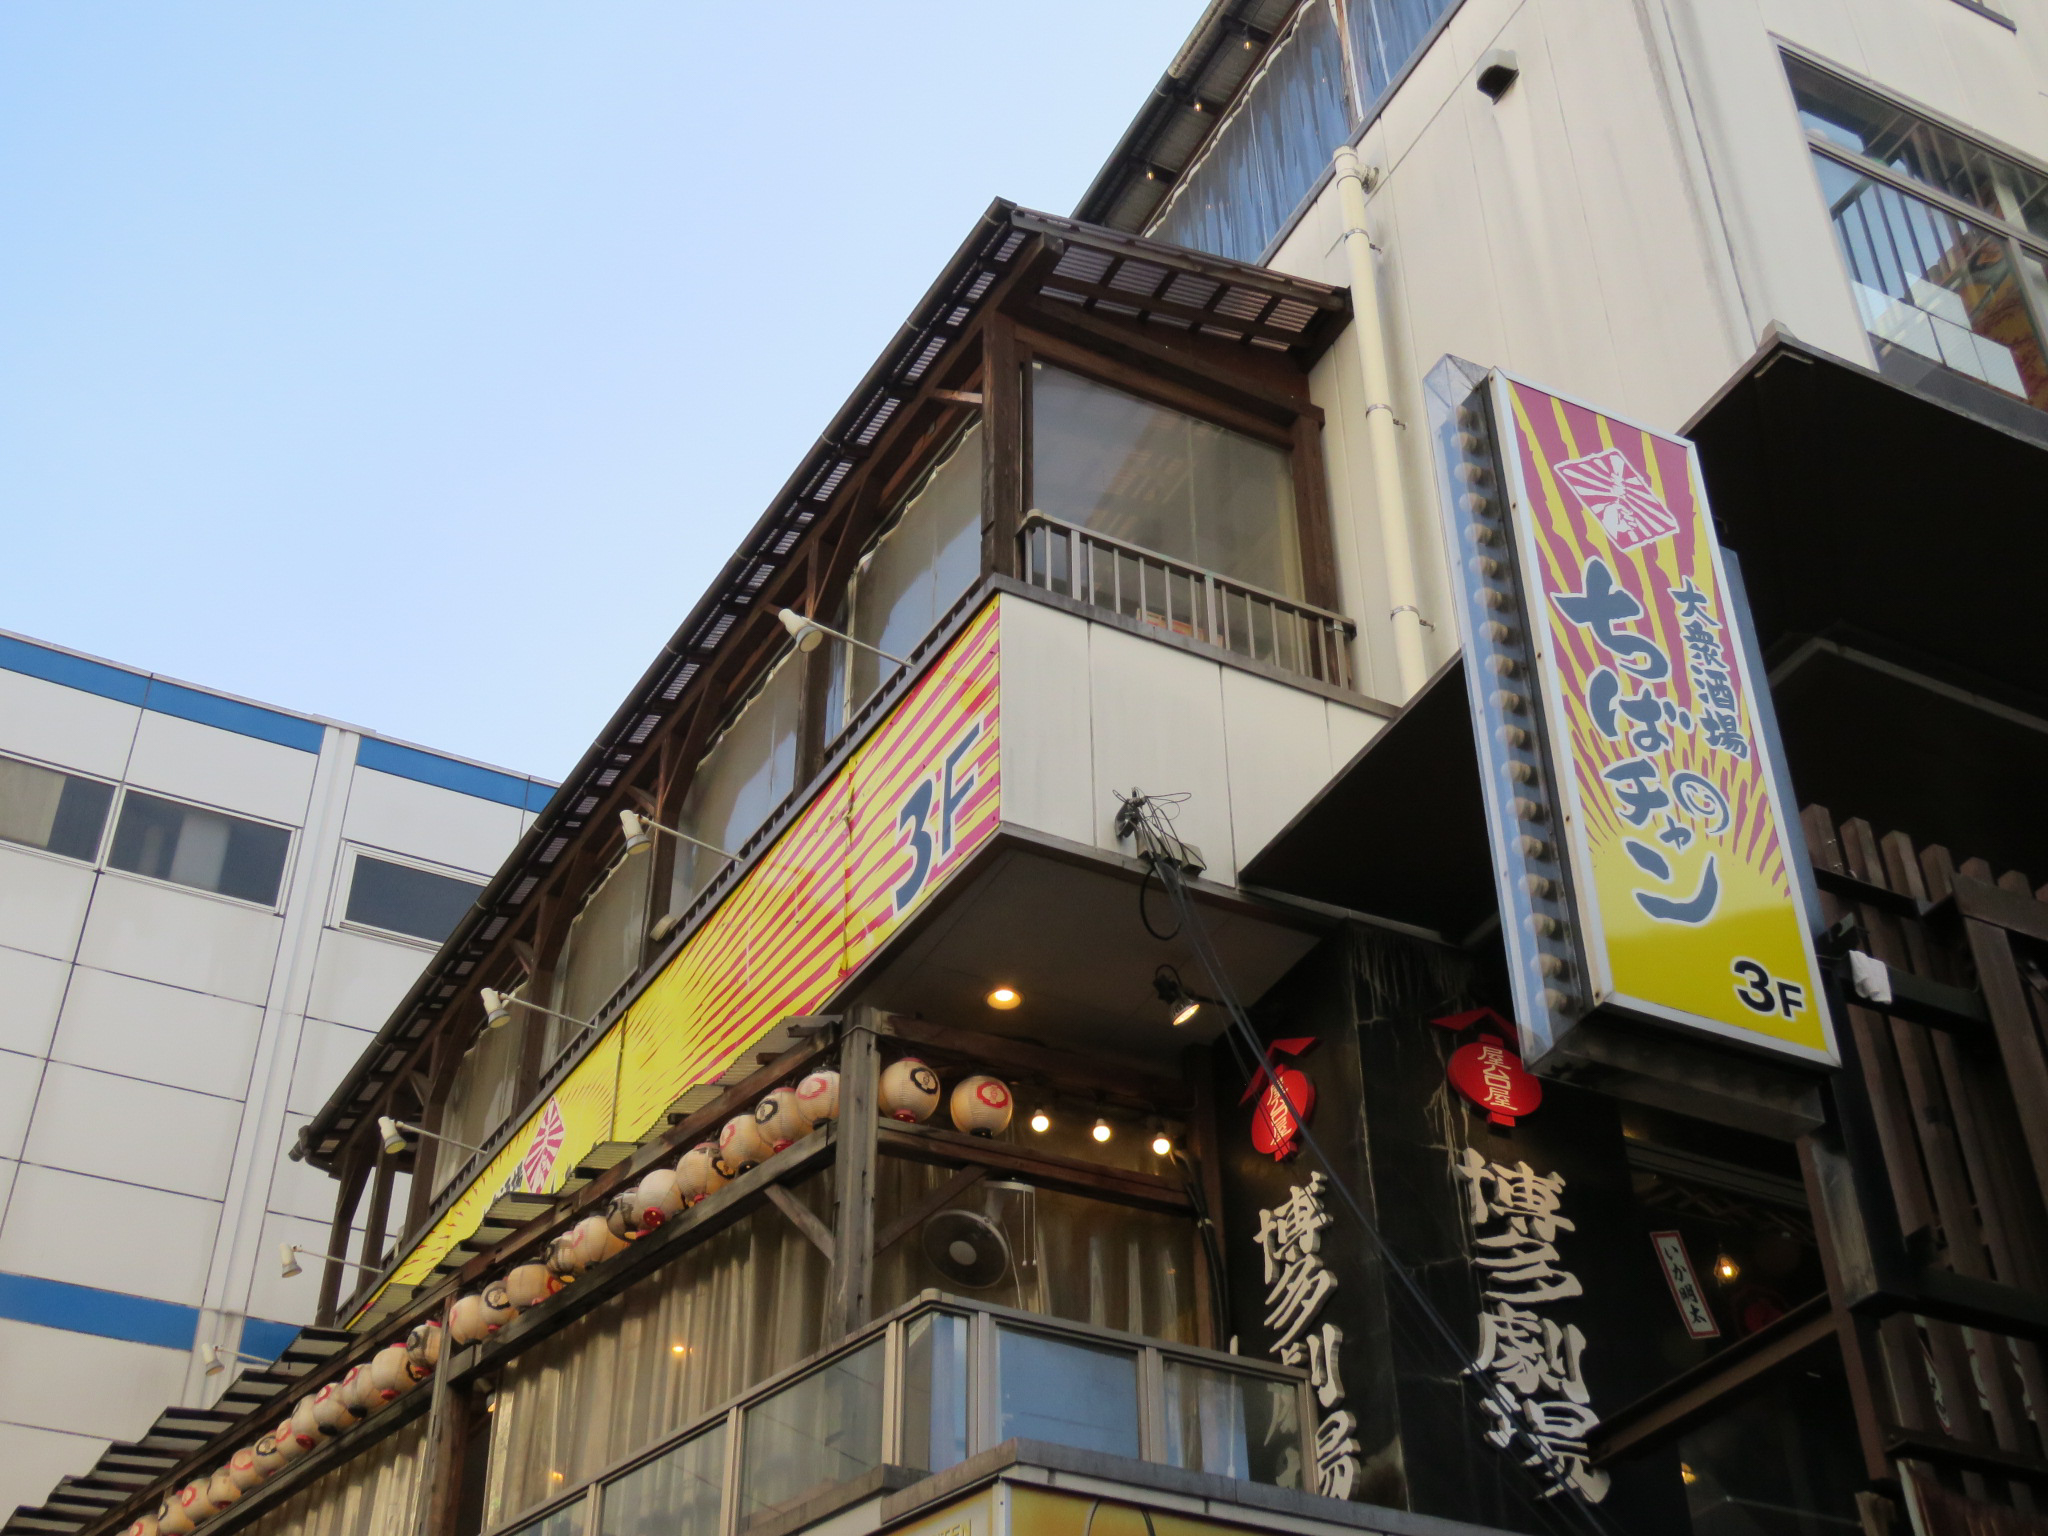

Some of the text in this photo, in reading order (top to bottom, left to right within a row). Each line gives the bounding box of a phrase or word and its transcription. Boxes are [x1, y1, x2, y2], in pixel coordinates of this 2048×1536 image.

[1670, 576, 1749, 760] 大衆酒場
[896, 717, 983, 915] 3F
[1732, 960, 1805, 1018] 3F
[1477, 1046, 1518, 1111] 屋台屋
[1454, 1147, 1610, 1504] 博多劇場
[1664, 1246, 1707, 1324] いか明太
